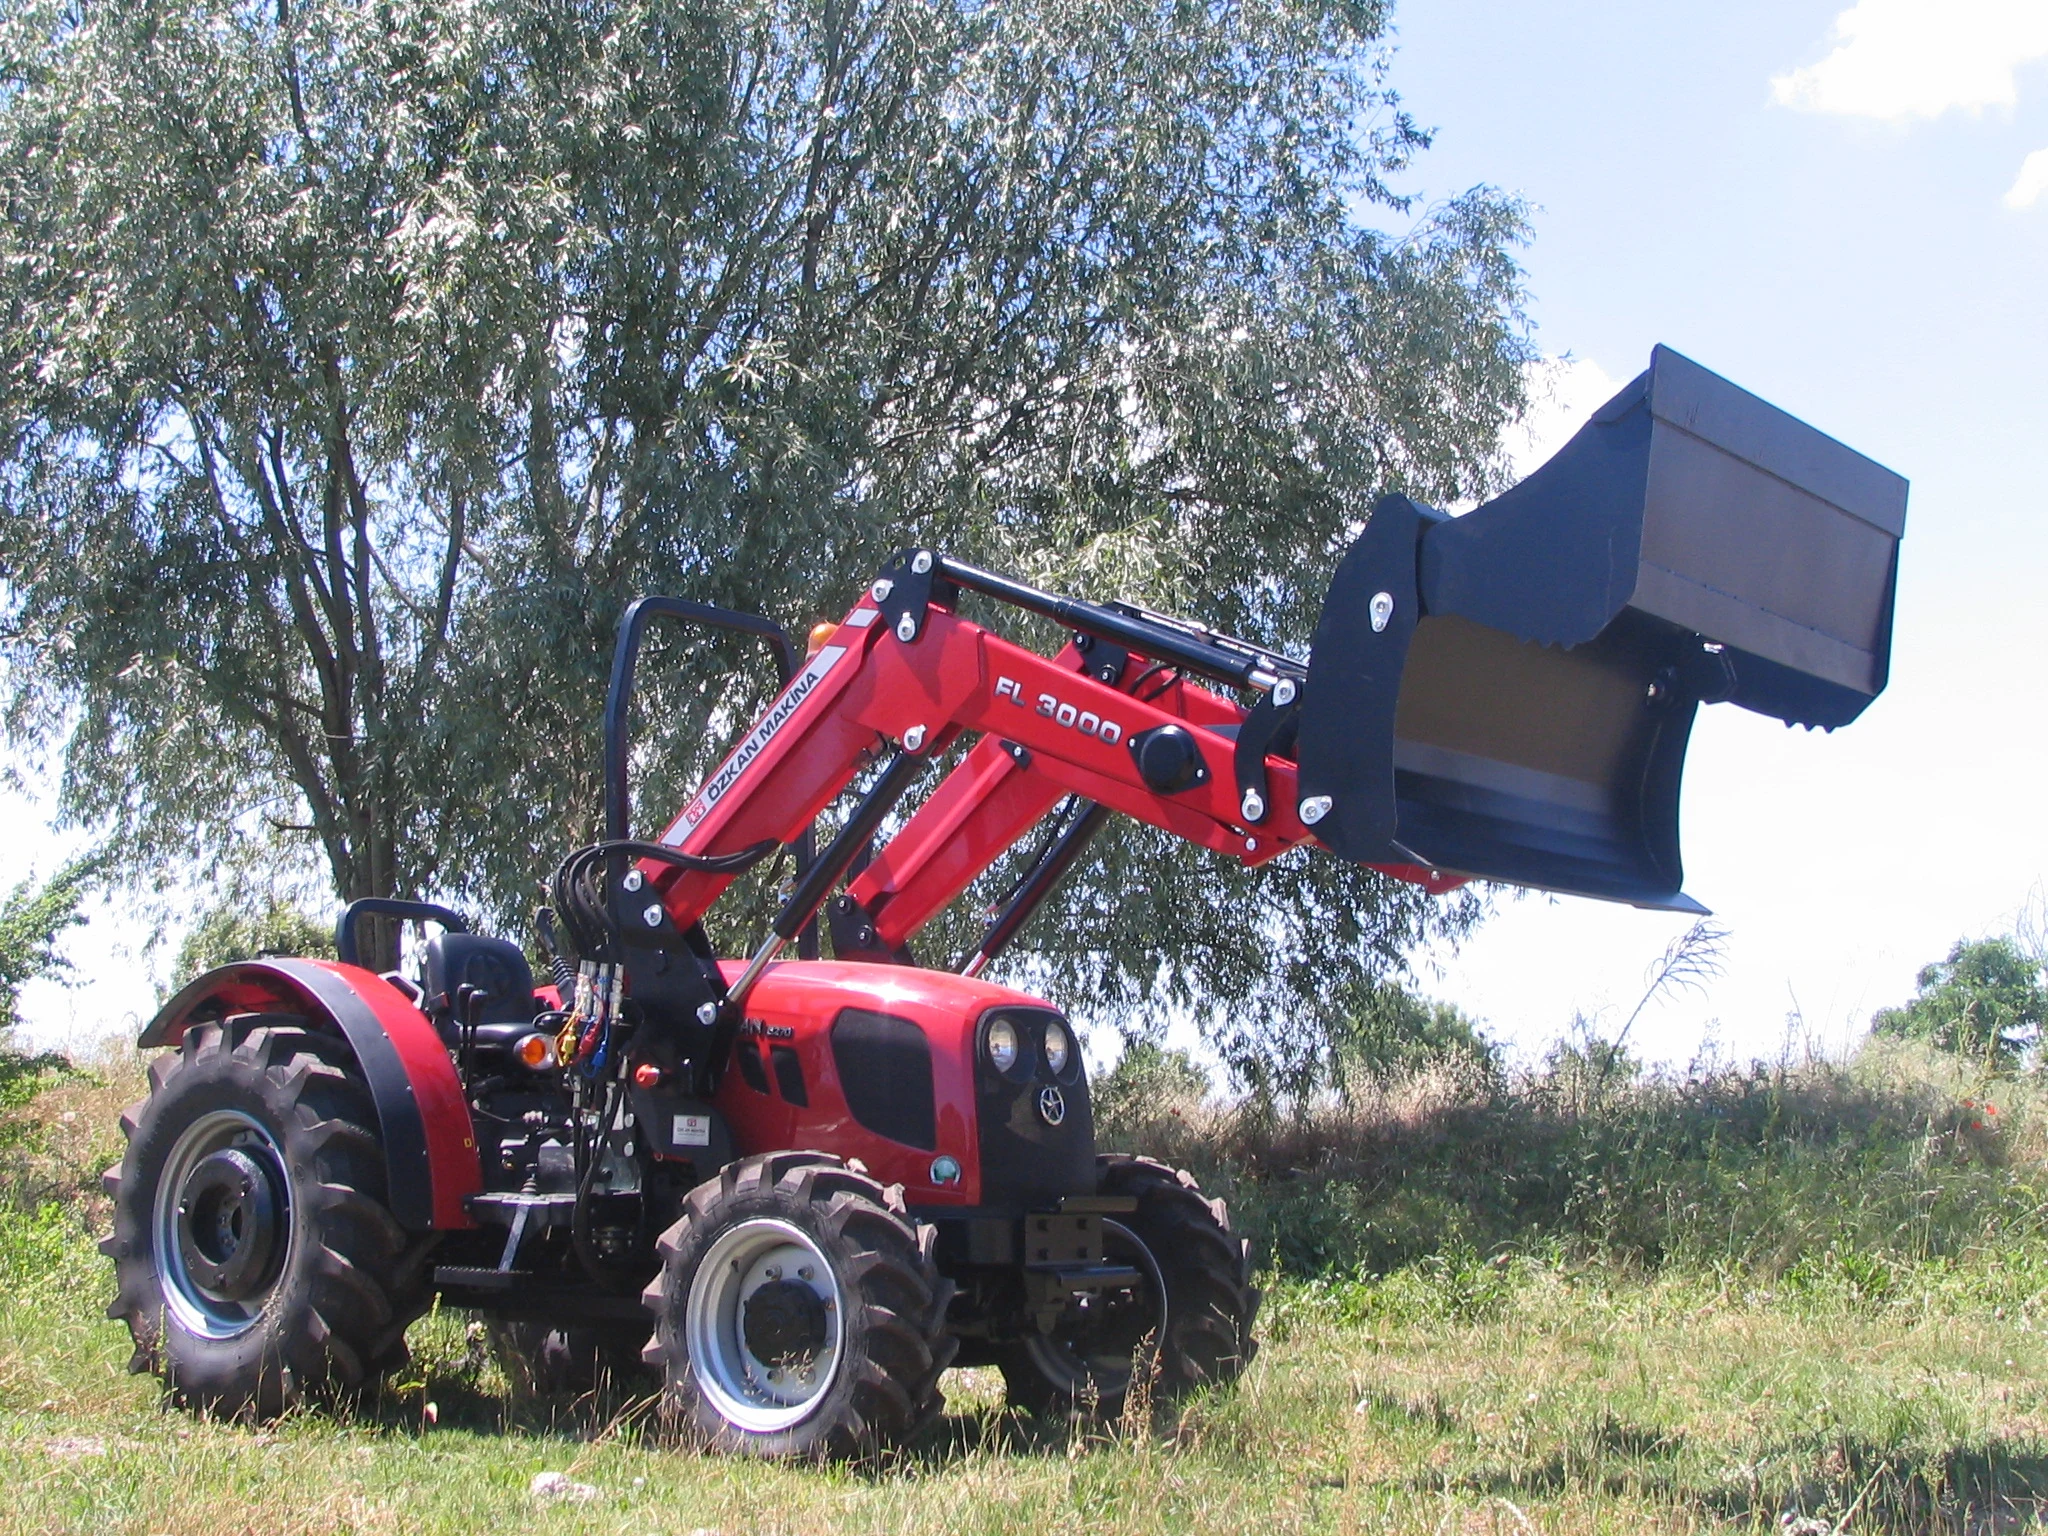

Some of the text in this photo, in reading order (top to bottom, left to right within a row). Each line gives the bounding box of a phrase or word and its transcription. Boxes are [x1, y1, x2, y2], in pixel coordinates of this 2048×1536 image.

[707, 672, 819, 801] ÖZKAN MAKİNA
[995, 676, 1122, 745] FL 3000
